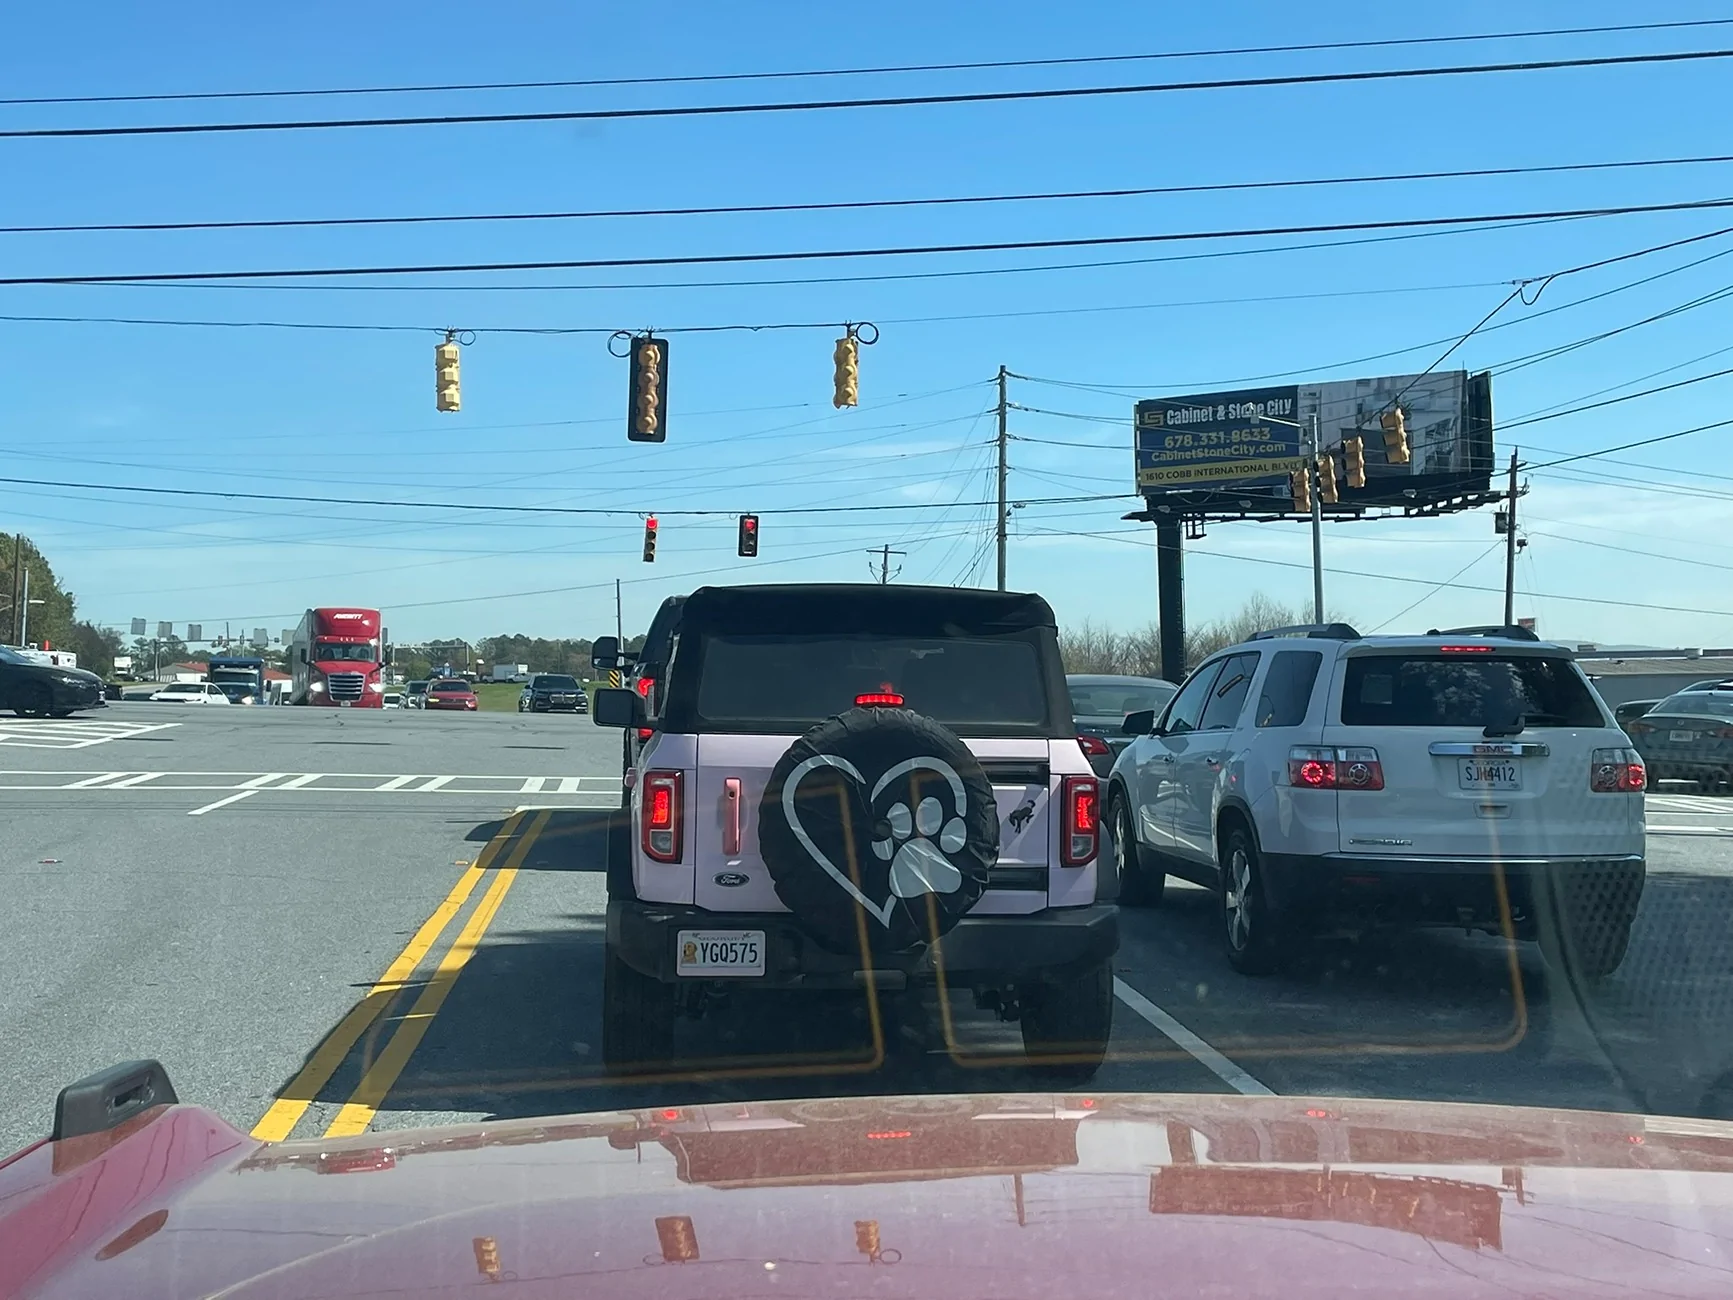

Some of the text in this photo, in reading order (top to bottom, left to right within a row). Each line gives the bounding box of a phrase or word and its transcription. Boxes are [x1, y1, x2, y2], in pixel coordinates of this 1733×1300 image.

[1166, 398, 1293, 426] Cabinet & Stone City
[1164, 427, 1271, 449] 678.331.8633
[1151, 442, 1286, 462] CabinetStoneCity.com
[1145, 471, 1165, 481] 1610
[1166, 469, 1192, 480] COBB
[1194, 463, 1269, 478] INTERNATIONAL
[720, 875, 741, 885] Ford
[700, 942, 758, 963] YGQ575
